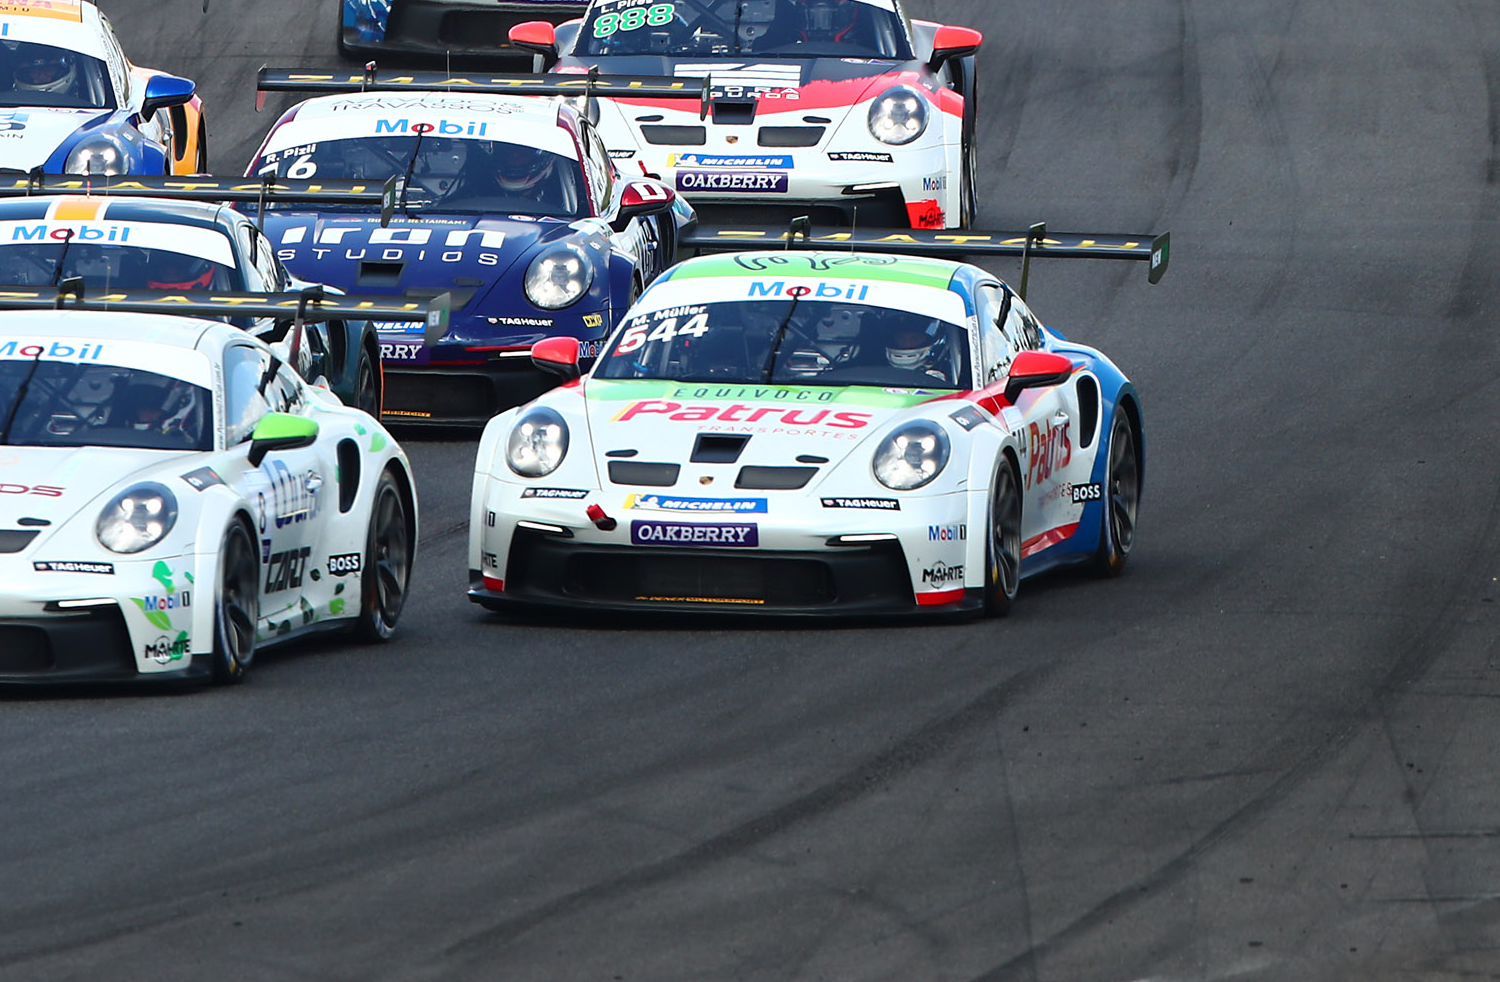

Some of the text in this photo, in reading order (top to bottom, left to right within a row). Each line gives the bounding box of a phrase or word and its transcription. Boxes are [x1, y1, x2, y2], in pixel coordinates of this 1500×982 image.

[593, 3, 675, 39] 888
[375, 118, 488, 137] Mobil
[265, 153, 280, 164] R.
[701, 157, 784, 167] MICHELIN
[682, 173, 783, 190] OAKBERRY
[11, 224, 130, 243] Mobil
[276, 247, 500, 266] STUDIOS
[747, 280, 869, 301] Mobil
[630, 305, 707, 328] M. Müller
[618, 313, 709, 353] 544
[673, 388, 834, 402] EQUIVOCO
[616, 400, 873, 429] Patrus
[697, 424, 860, 441] TRANSPORTES
[1073, 484, 1101, 501] BOSS
[661, 499, 757, 511] MICHELIN
[637, 525, 750, 543] OAKBERRY
[928, 523, 967, 541] Mobil 1
[329, 555, 359, 572] BOSS
[144, 591, 190, 612] Mobil 1
